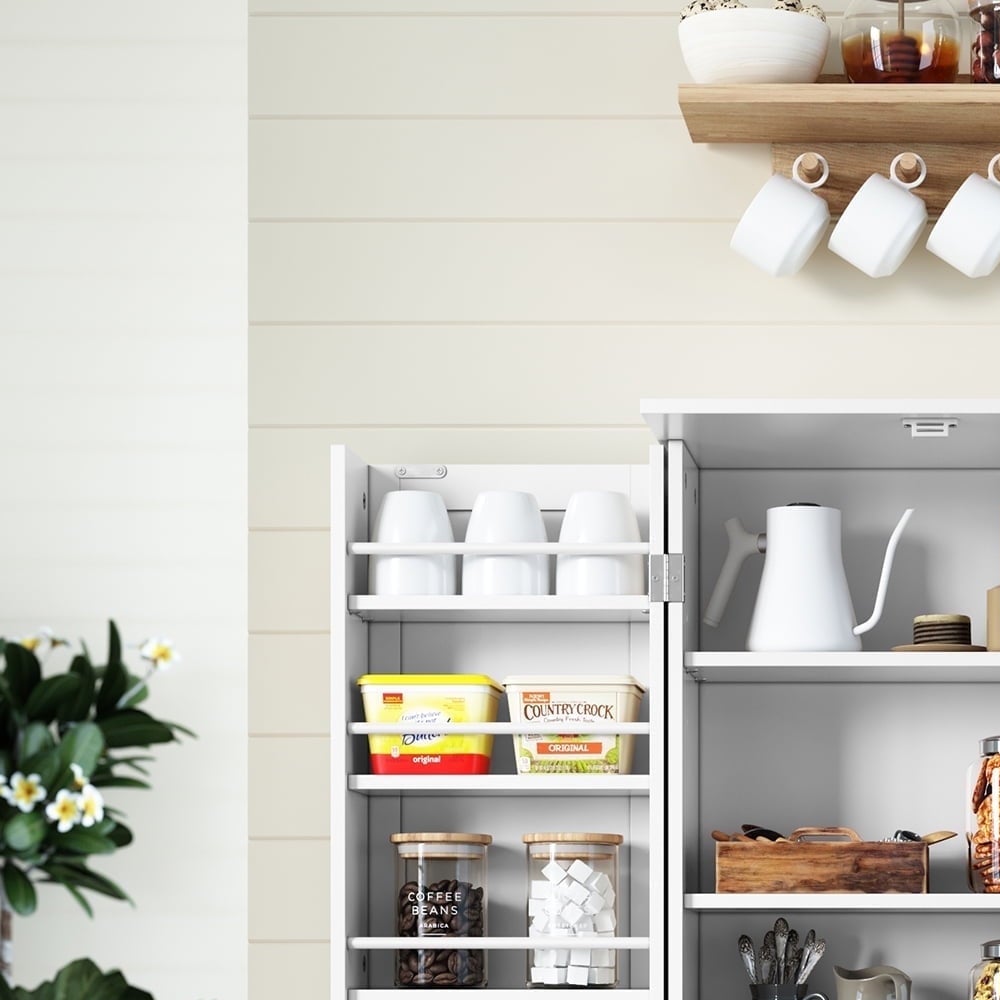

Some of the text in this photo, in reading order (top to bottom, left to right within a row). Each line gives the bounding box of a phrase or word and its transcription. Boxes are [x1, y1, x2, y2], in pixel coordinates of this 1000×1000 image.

[524, 703, 615, 720] COUNTRY CROCK
[548, 744, 590, 752] ORIGINAL
[412, 756, 441, 764] original
[408, 892, 462, 902] COFFEE
[412, 906, 458, 915] BEANS
